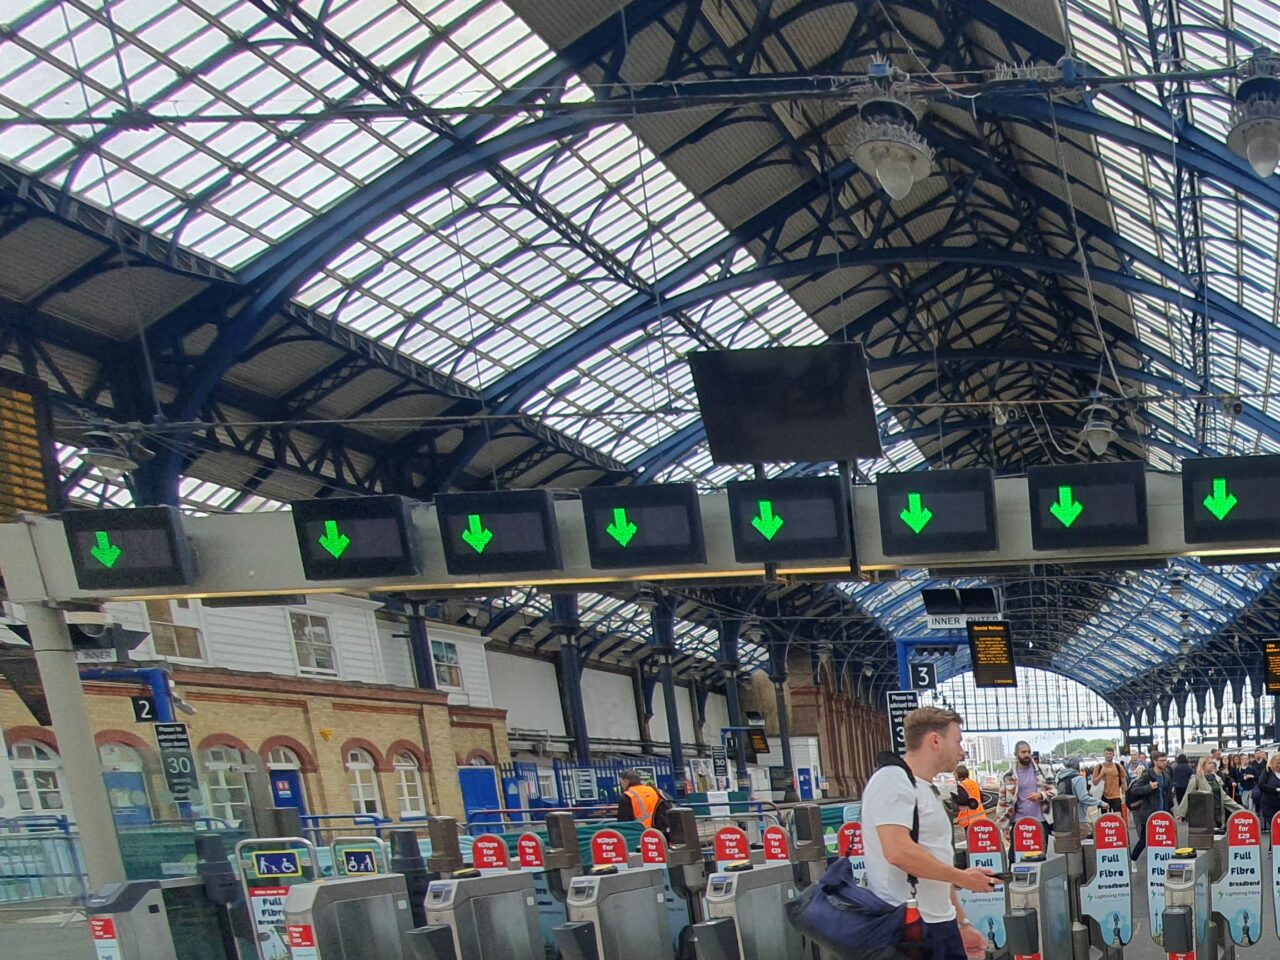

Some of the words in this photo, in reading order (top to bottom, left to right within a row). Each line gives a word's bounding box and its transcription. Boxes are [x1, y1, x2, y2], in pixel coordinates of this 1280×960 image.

[918, 667, 929, 685] 3
[139, 701, 152, 718] 2
[896, 726, 905, 742] 3
[168, 757, 191, 774] 30
[1102, 855, 1119, 863] Full
[1099, 870, 1123, 878] Fibre
[1231, 866, 1255, 875] Fibre
[263, 898, 282, 906] Full
